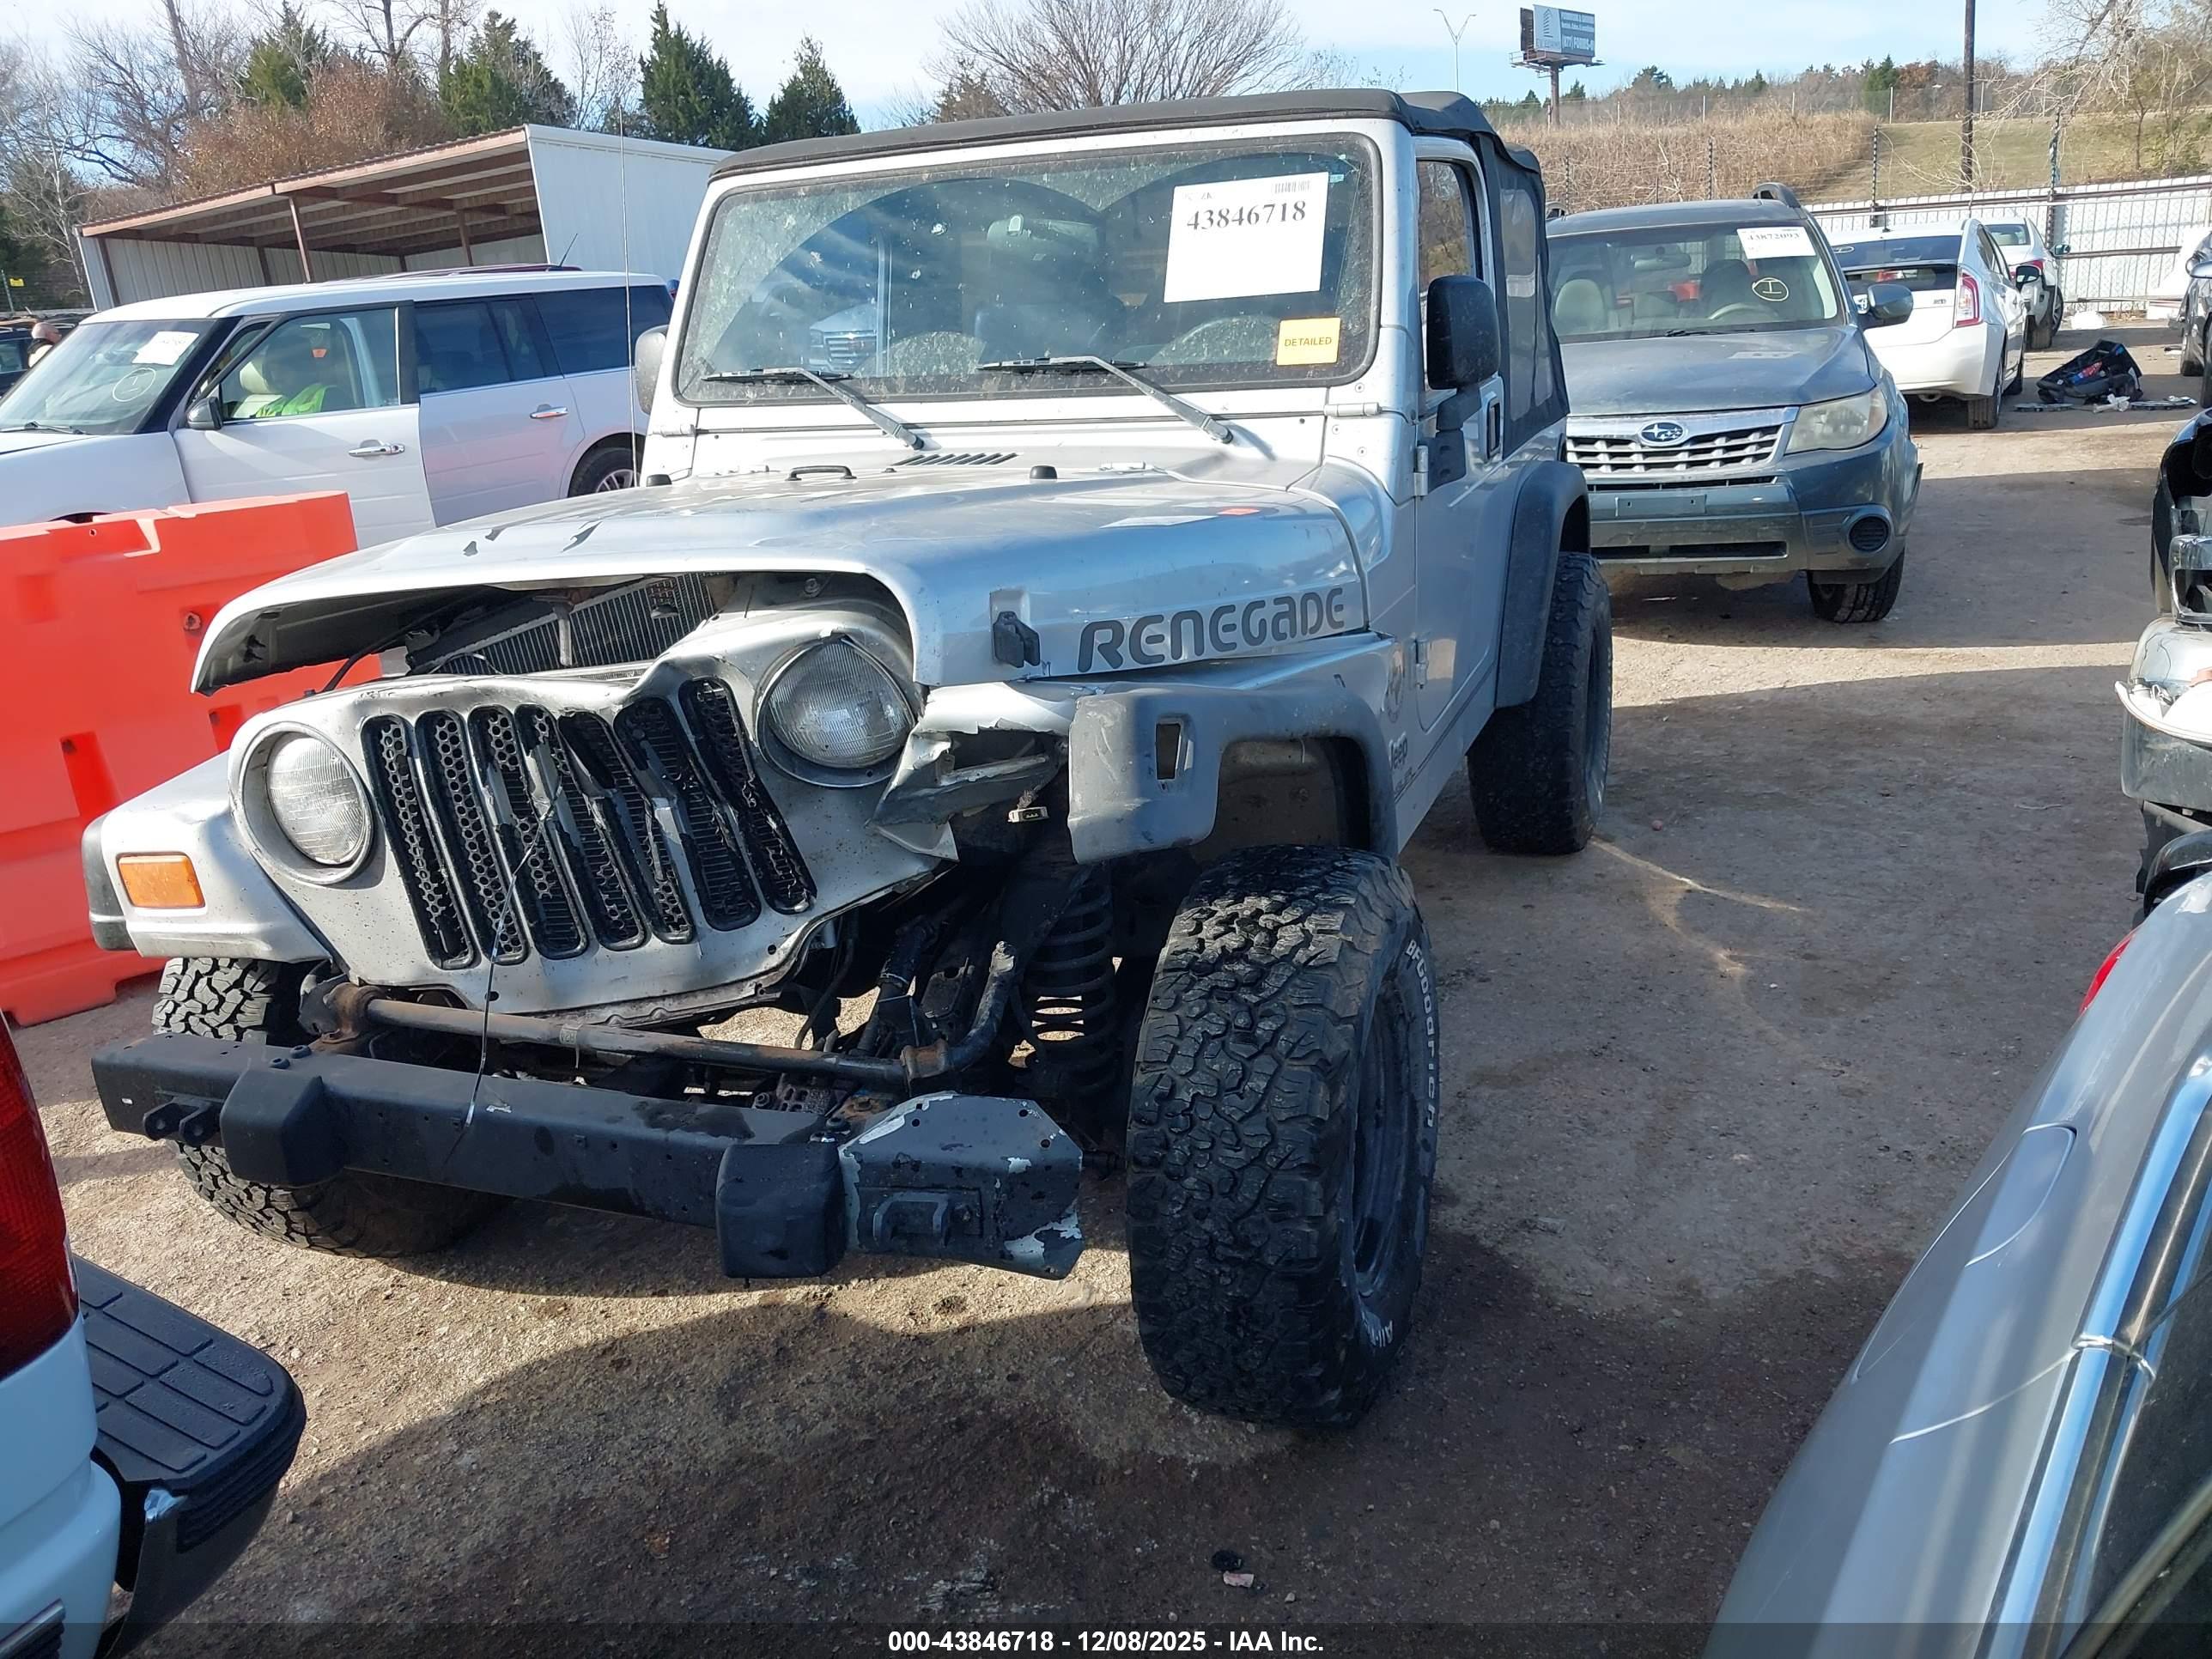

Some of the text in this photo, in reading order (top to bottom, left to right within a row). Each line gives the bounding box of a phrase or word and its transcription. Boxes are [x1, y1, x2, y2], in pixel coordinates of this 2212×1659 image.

[1187, 200, 1306, 230] 43846718
[1285, 337, 1333, 347] DETAILED
[1077, 587, 1345, 672] RENEGADE
